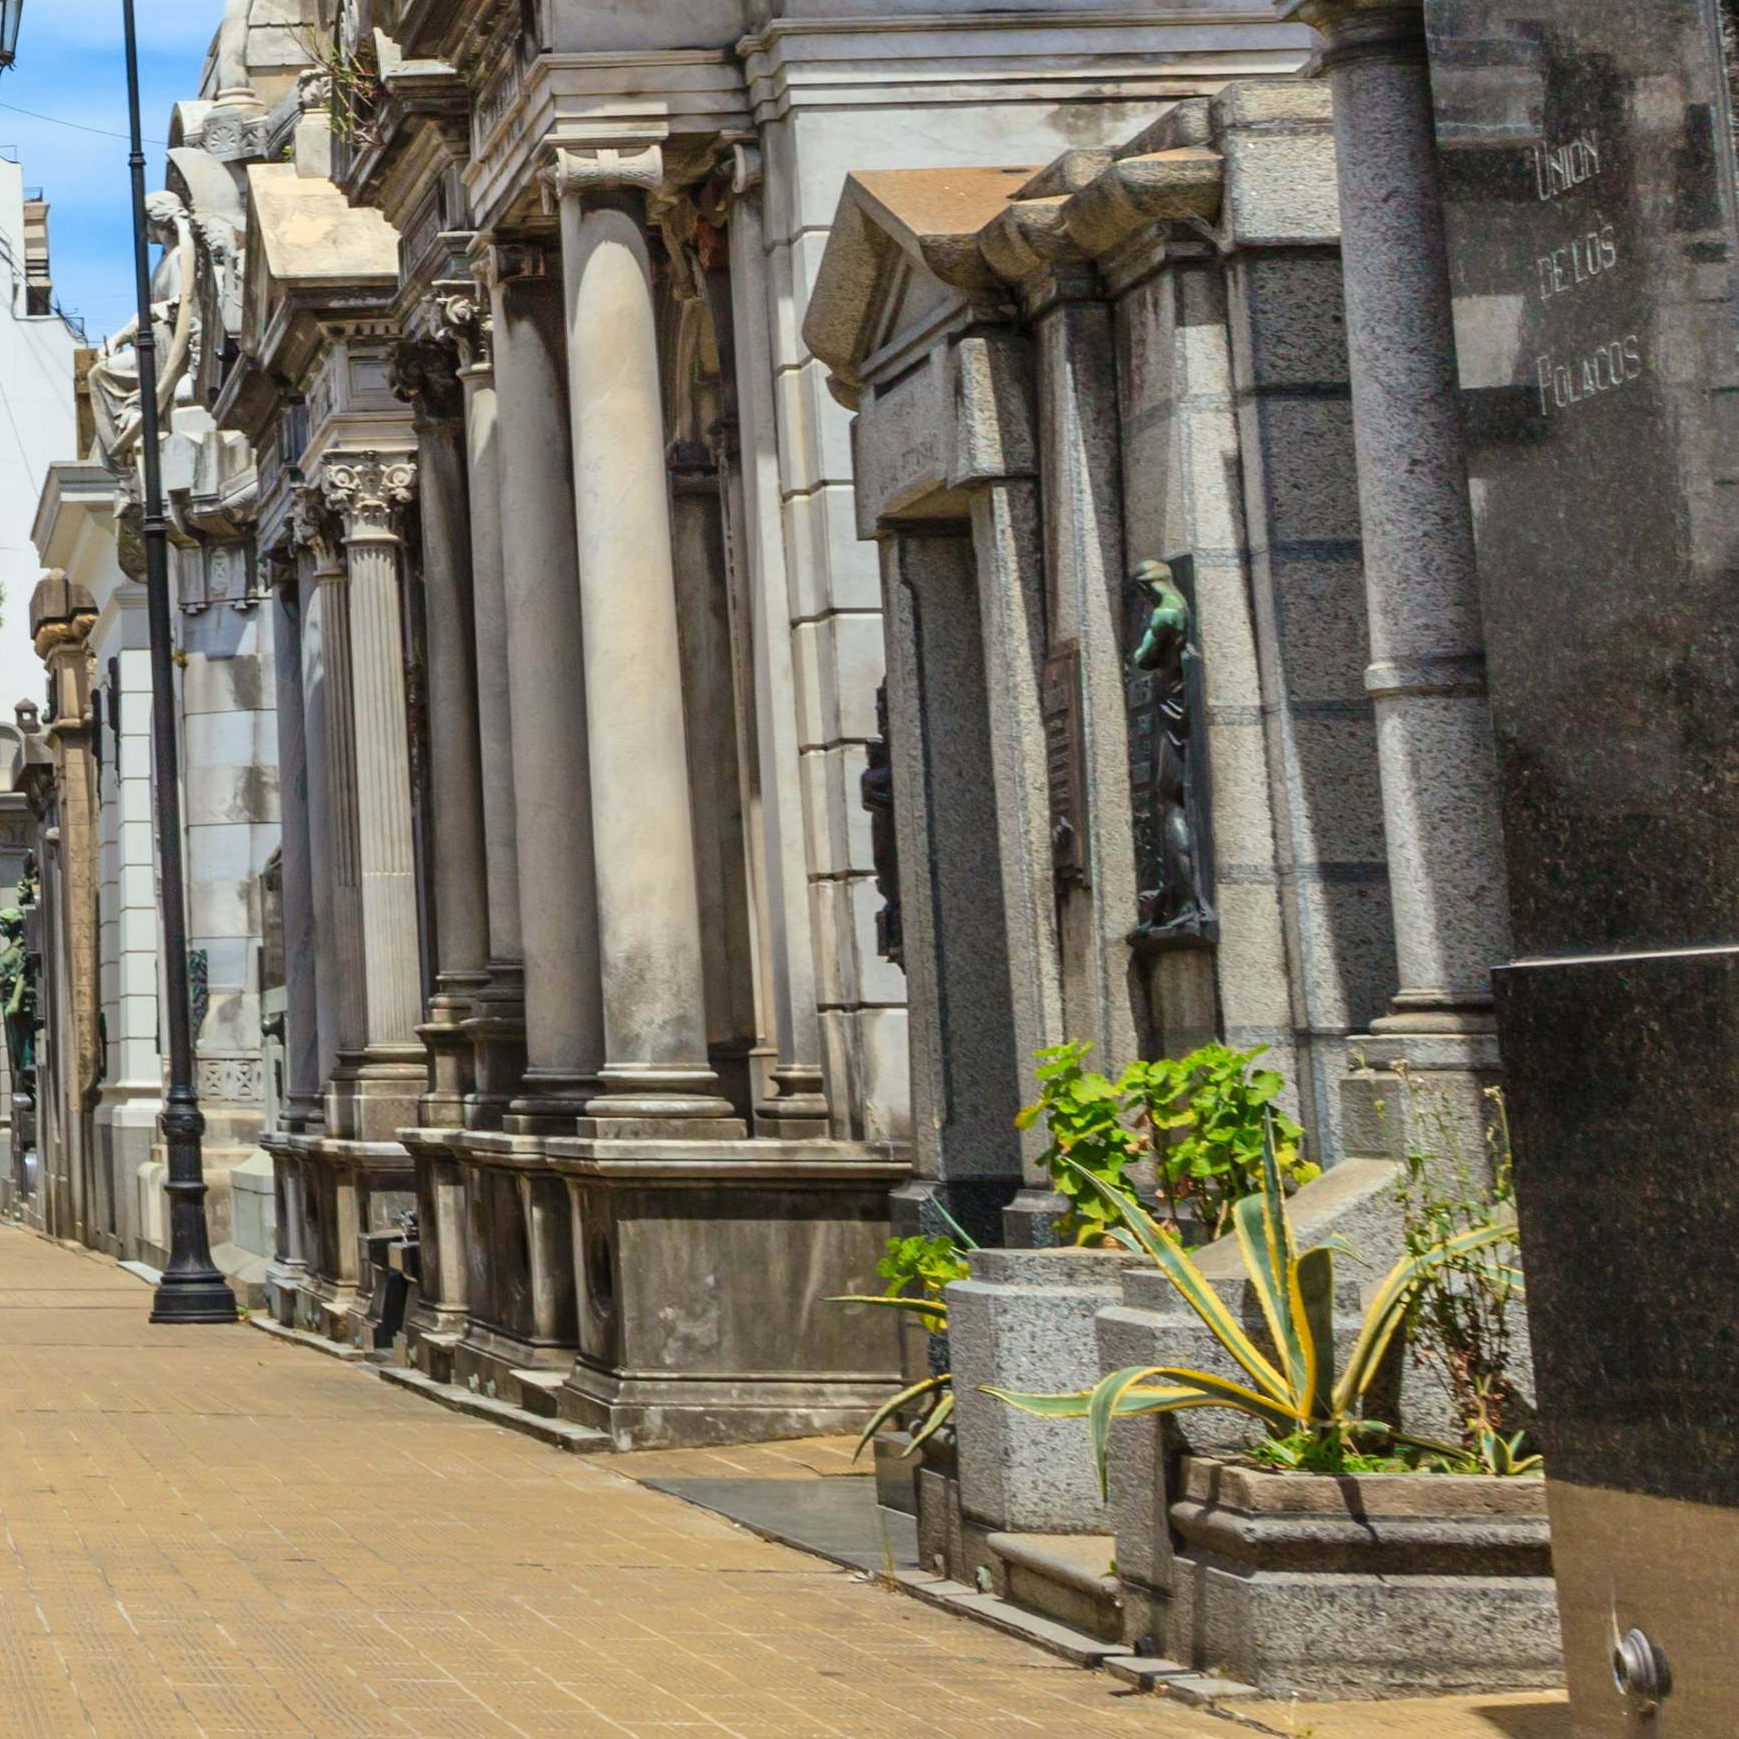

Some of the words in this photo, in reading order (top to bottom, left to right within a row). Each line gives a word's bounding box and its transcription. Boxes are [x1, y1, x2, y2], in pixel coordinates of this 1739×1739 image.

[1533, 129, 1601, 201] UNION
[1537, 249, 1569, 300] DE
[1572, 225, 1617, 284] LOS
[1537, 334, 1642, 416] POLACOS
